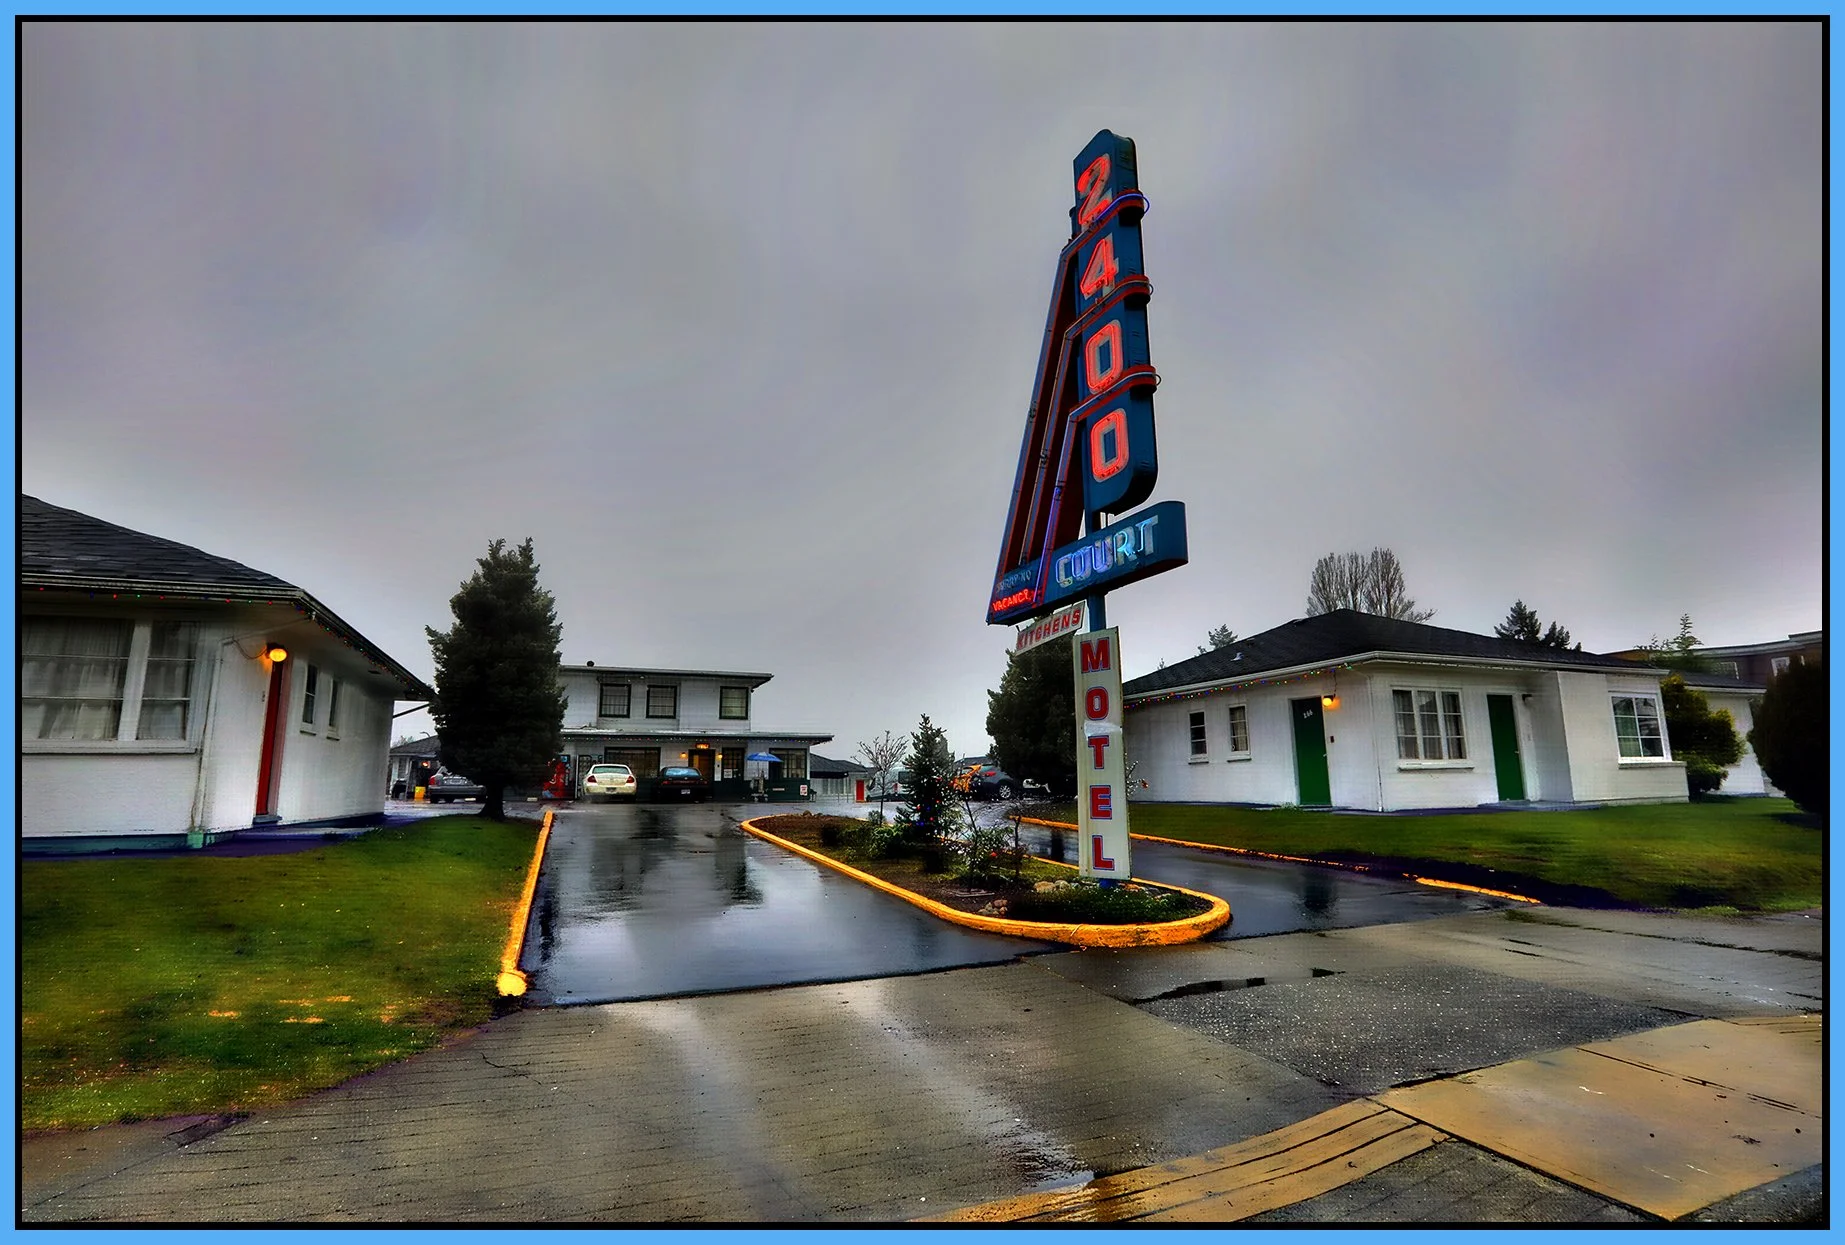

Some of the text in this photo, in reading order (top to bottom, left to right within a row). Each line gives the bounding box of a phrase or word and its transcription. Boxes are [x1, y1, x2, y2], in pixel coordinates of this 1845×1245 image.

[1077, 153, 1129, 483] 2400
[1055, 515, 1158, 588] COURT
[1017, 609, 1081, 650] KITCHENS
[1081, 637, 1115, 871] MOTEL
